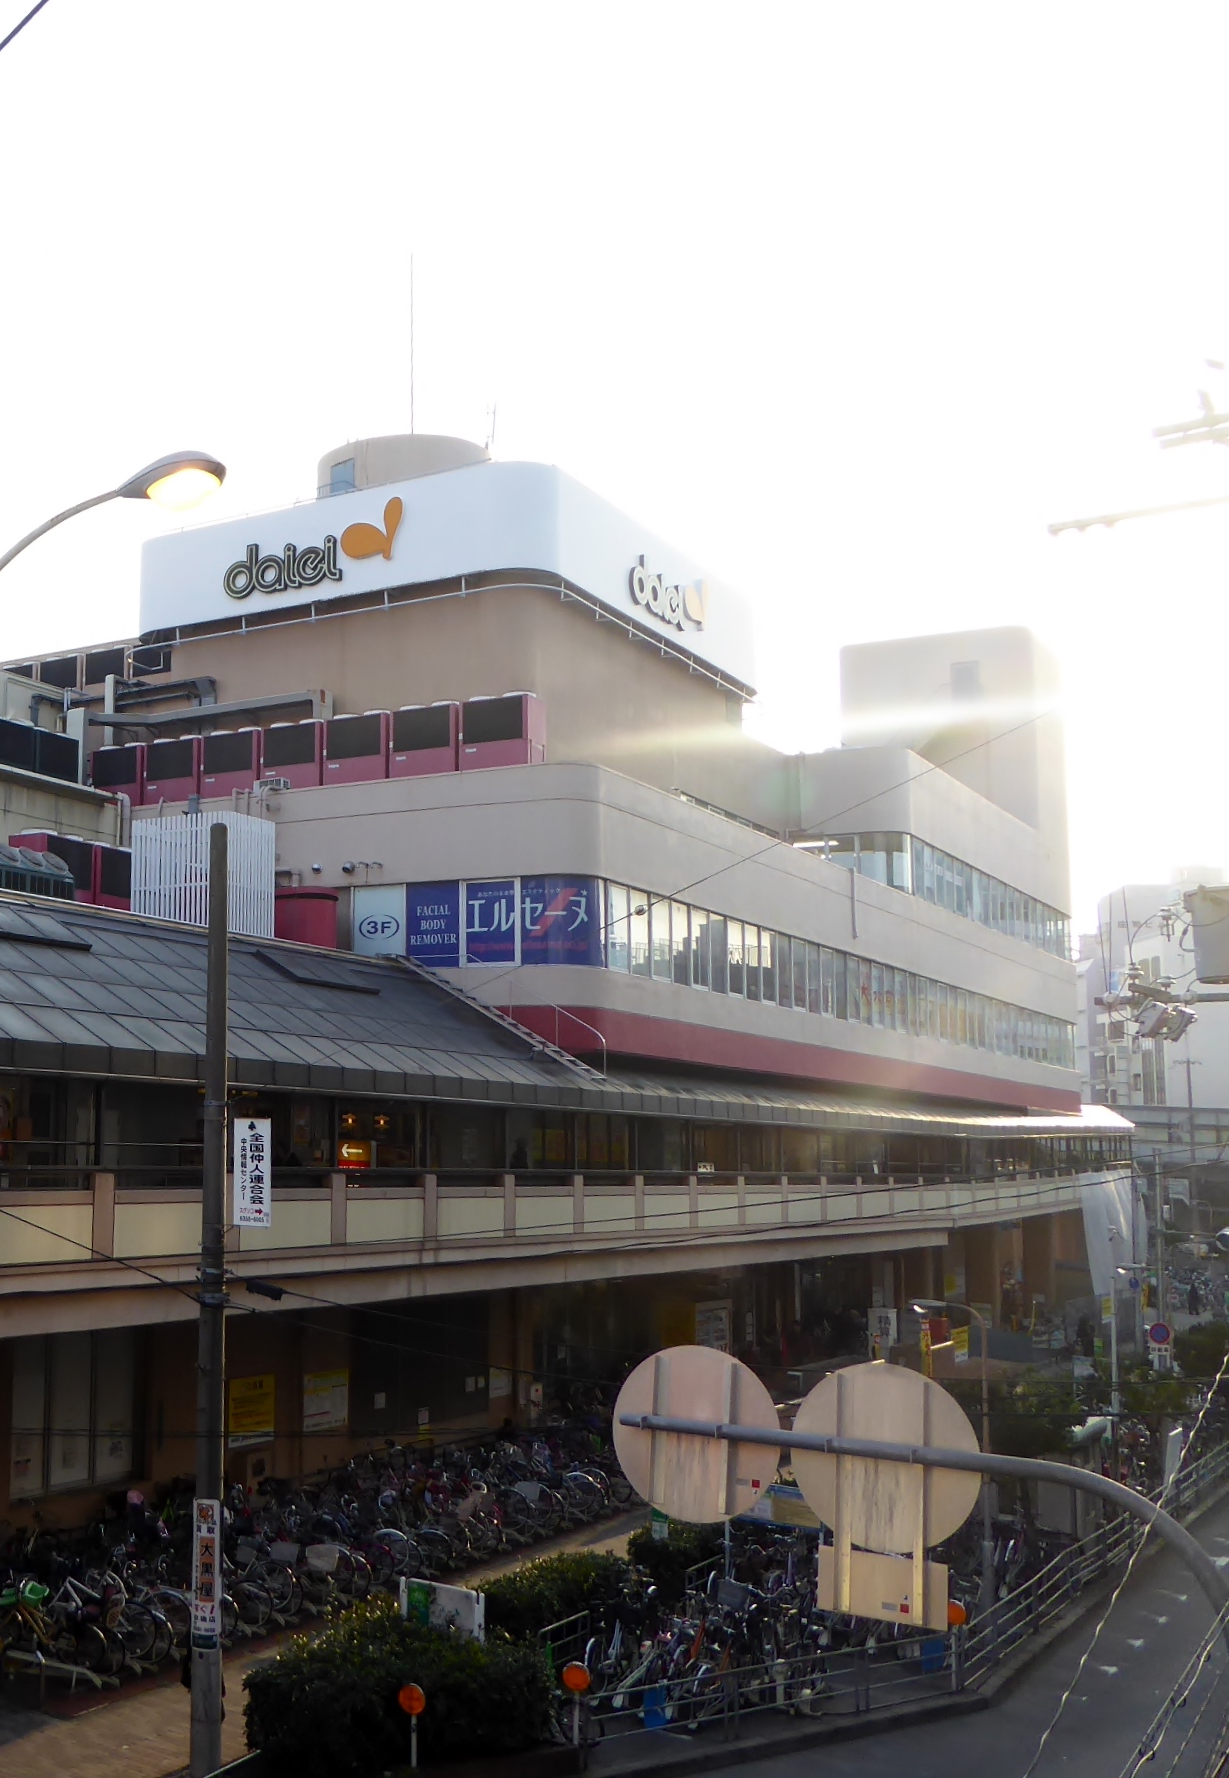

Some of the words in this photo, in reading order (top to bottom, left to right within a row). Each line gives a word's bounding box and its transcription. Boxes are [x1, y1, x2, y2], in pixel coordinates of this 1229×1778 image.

[223, 534, 343, 600] daiei
[366, 920, 392, 934] 3F
[416, 904, 451, 917] FACIAL
[420, 918, 447, 931] BODY
[466, 895, 589, 933] エルセーヌ
[410, 932, 458, 946] REMOVER
[240, 1137, 248, 1201] 中央情報センター
[249, 1132, 265, 1205] 全国仲人連合会
[200, 1543, 214, 1597] 大黒屋
